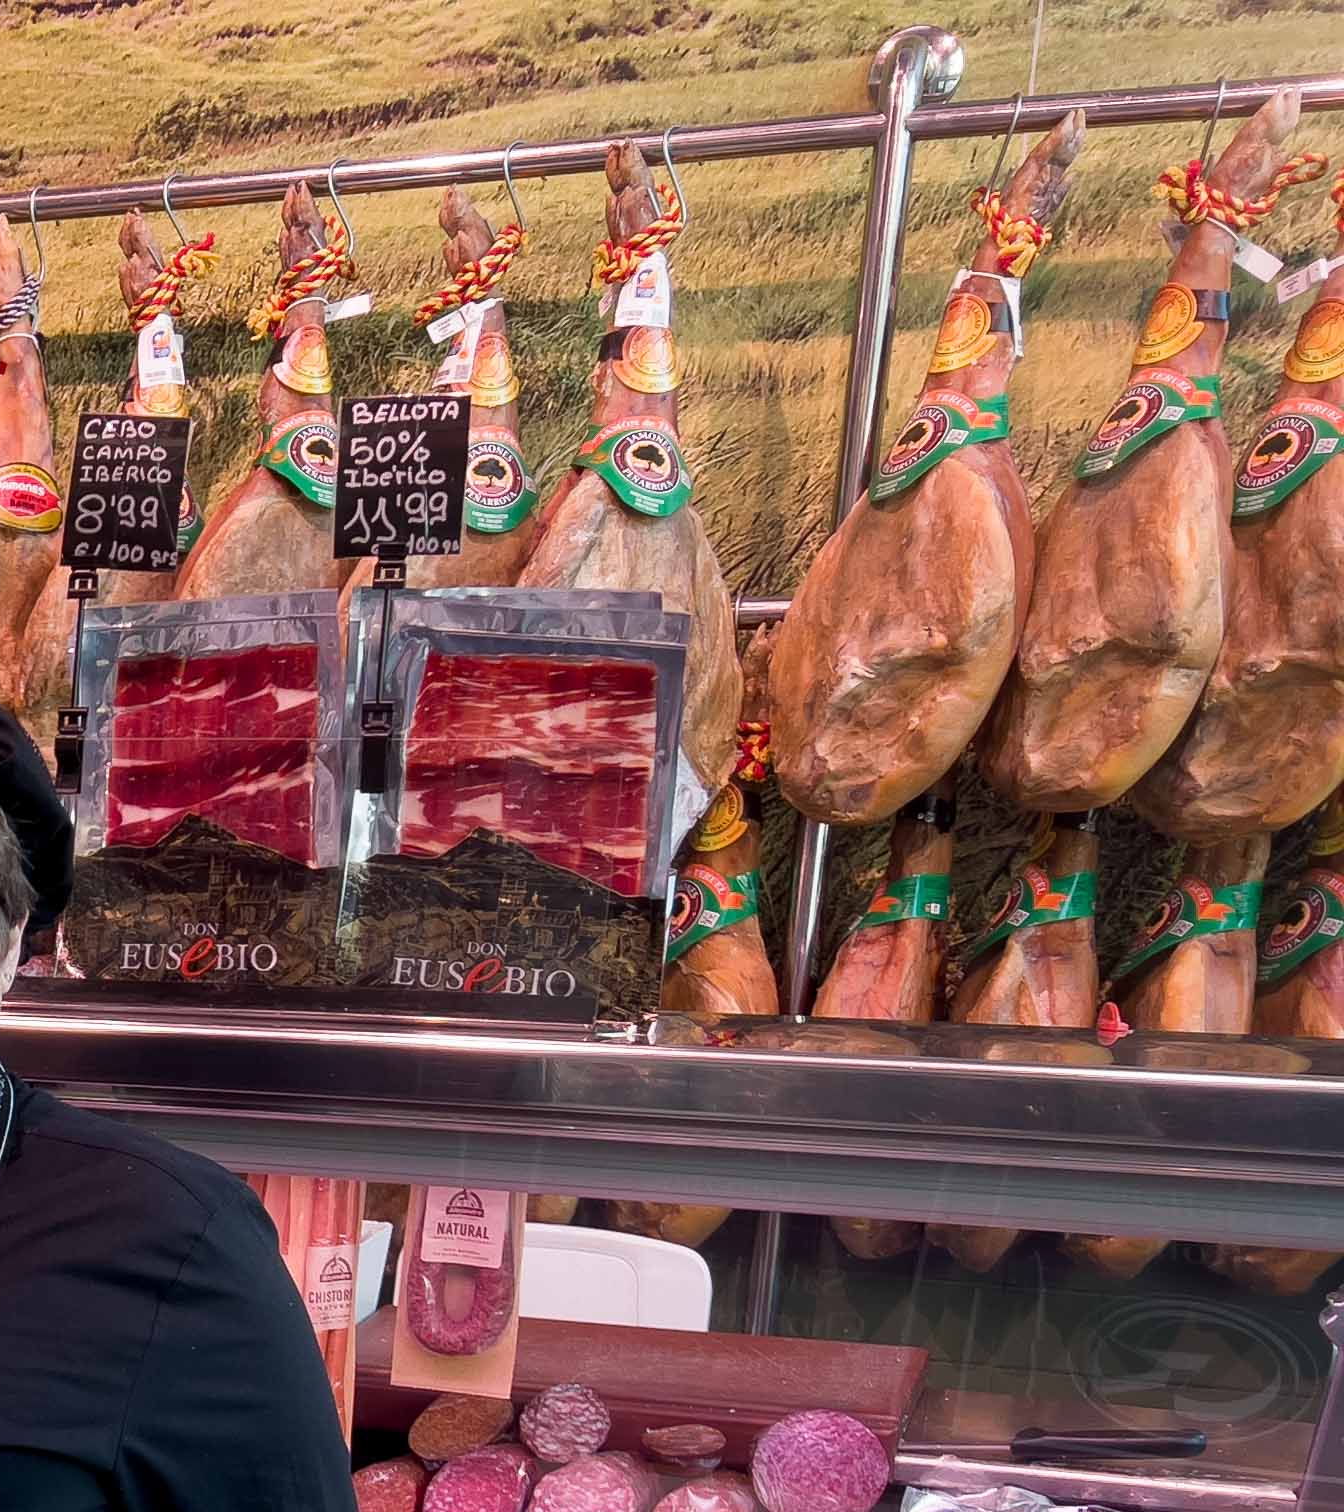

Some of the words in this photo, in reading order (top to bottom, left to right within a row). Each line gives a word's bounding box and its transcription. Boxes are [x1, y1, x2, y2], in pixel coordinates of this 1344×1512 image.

[351, 400, 461, 426] BELLOTA
[83, 419, 157, 440] CEBO
[82, 445, 168, 462] CAMPO
[350, 431, 431, 466] 50%
[74, 493, 160, 534] 8'99
[108, 540, 145, 562] 100
[182, 922, 220, 938] DON
[466, 940, 509, 957] DON
[436, 1221, 490, 1241] NATURAL
